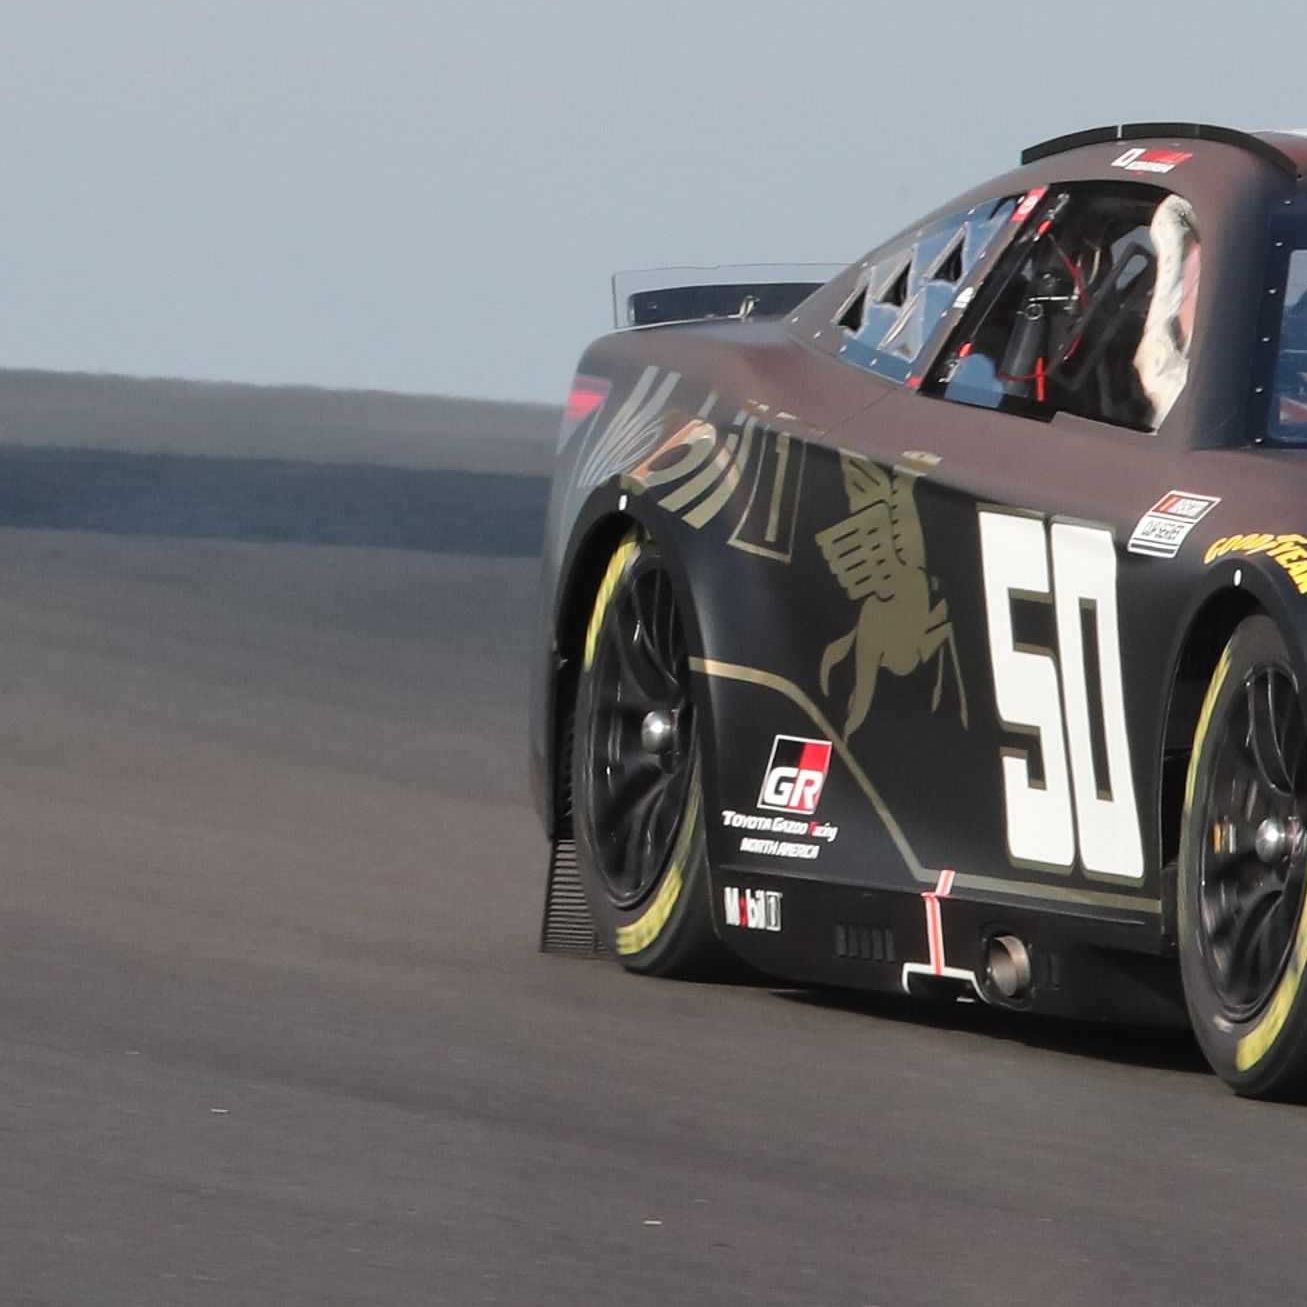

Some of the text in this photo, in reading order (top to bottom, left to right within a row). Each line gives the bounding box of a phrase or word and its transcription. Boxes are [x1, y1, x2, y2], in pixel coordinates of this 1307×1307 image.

[977, 506, 1145, 884] 50
[763, 766, 824, 810] GR
[722, 810, 773, 831] TOYOTA
[740, 837, 820, 859] NORTH AMERICA
